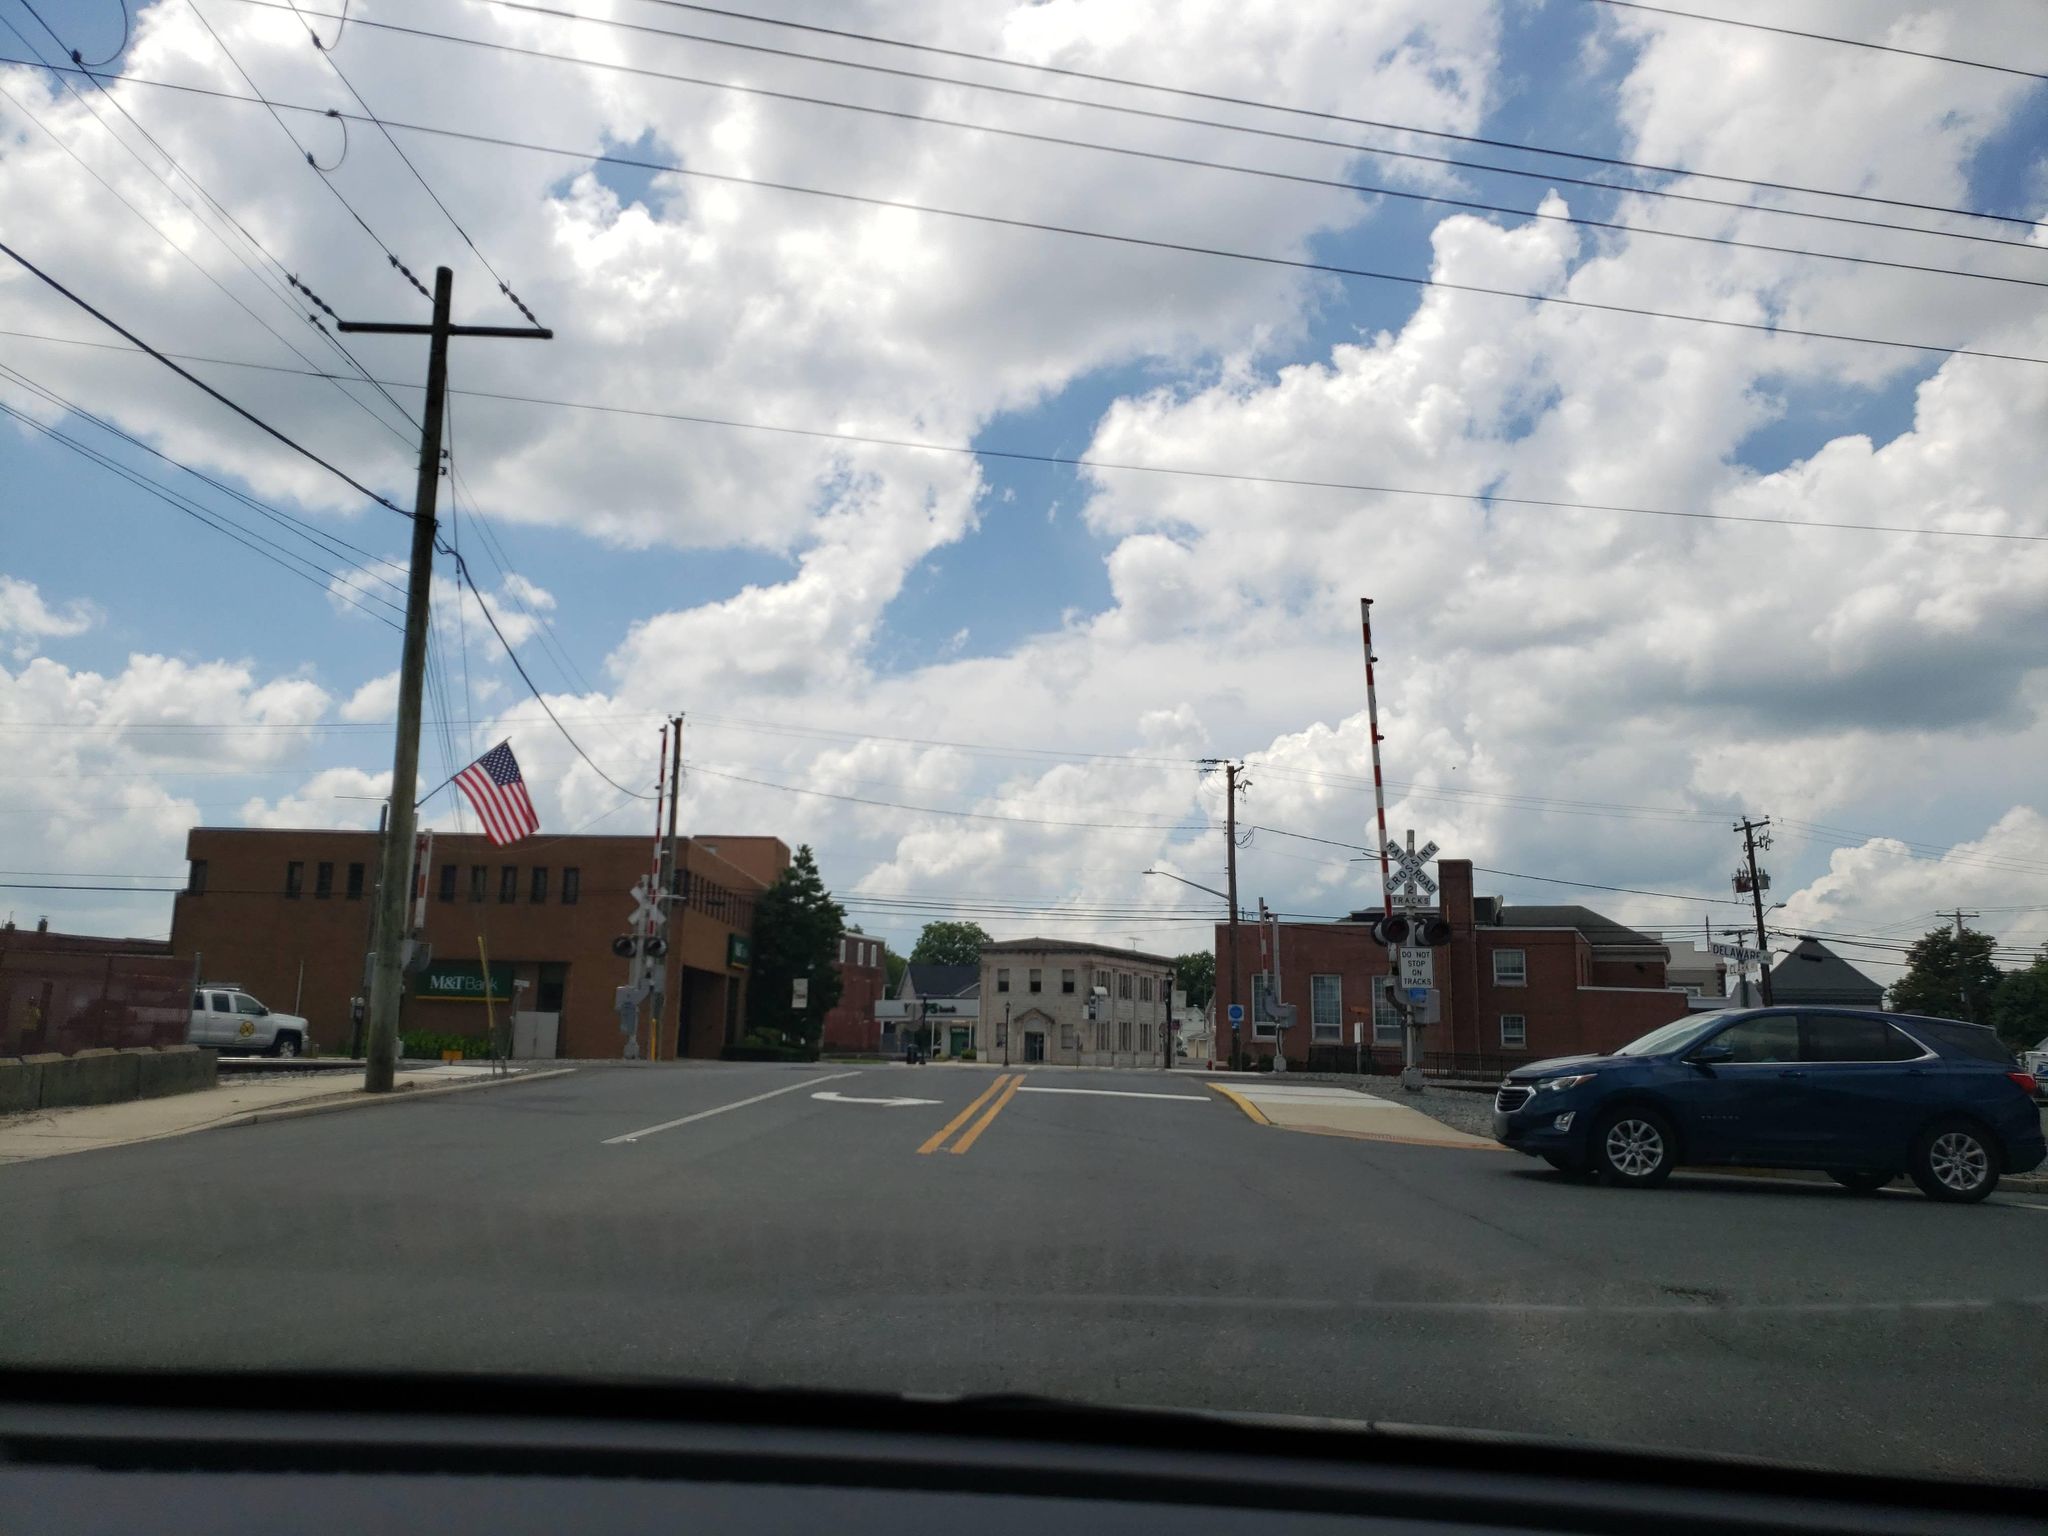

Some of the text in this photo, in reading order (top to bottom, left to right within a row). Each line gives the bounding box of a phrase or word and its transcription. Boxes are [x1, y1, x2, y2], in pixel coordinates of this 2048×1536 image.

[1386, 843, 1436, 891] CROSSING
[1407, 885, 1414, 894] 2
[1393, 896, 1429, 904] TRACKS
[1712, 944, 1761, 960] DELAWARE
[430, 975, 464, 990] M&T
